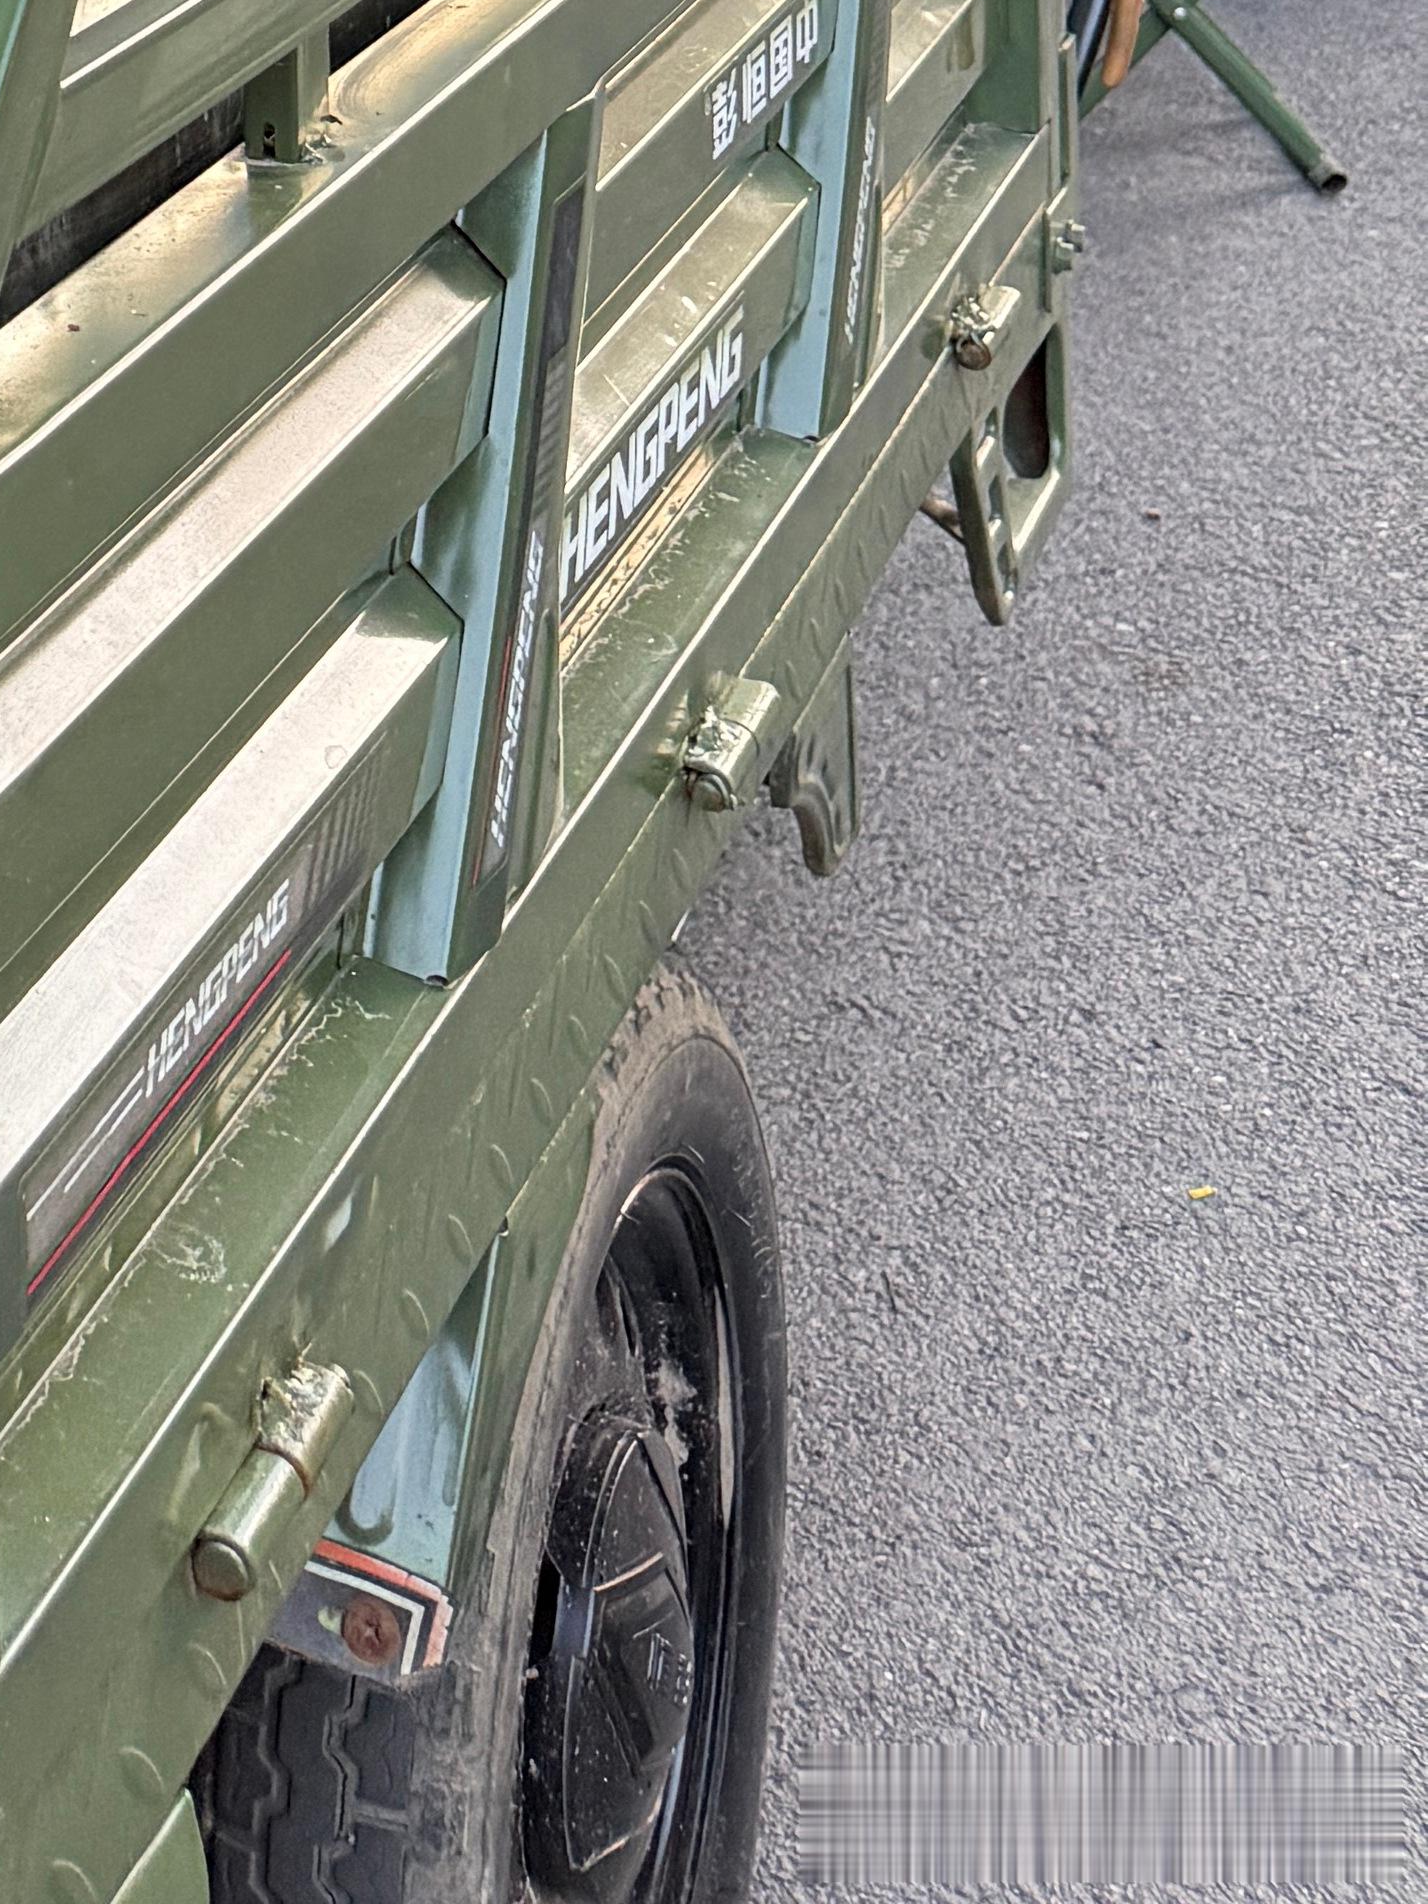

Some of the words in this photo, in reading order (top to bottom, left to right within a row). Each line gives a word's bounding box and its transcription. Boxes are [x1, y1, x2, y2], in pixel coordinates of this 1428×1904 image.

[558, 302, 744, 602] HENGPENG
[490, 529, 544, 849] HENGPENG
[145, 877, 291, 1099] HENGPENG
